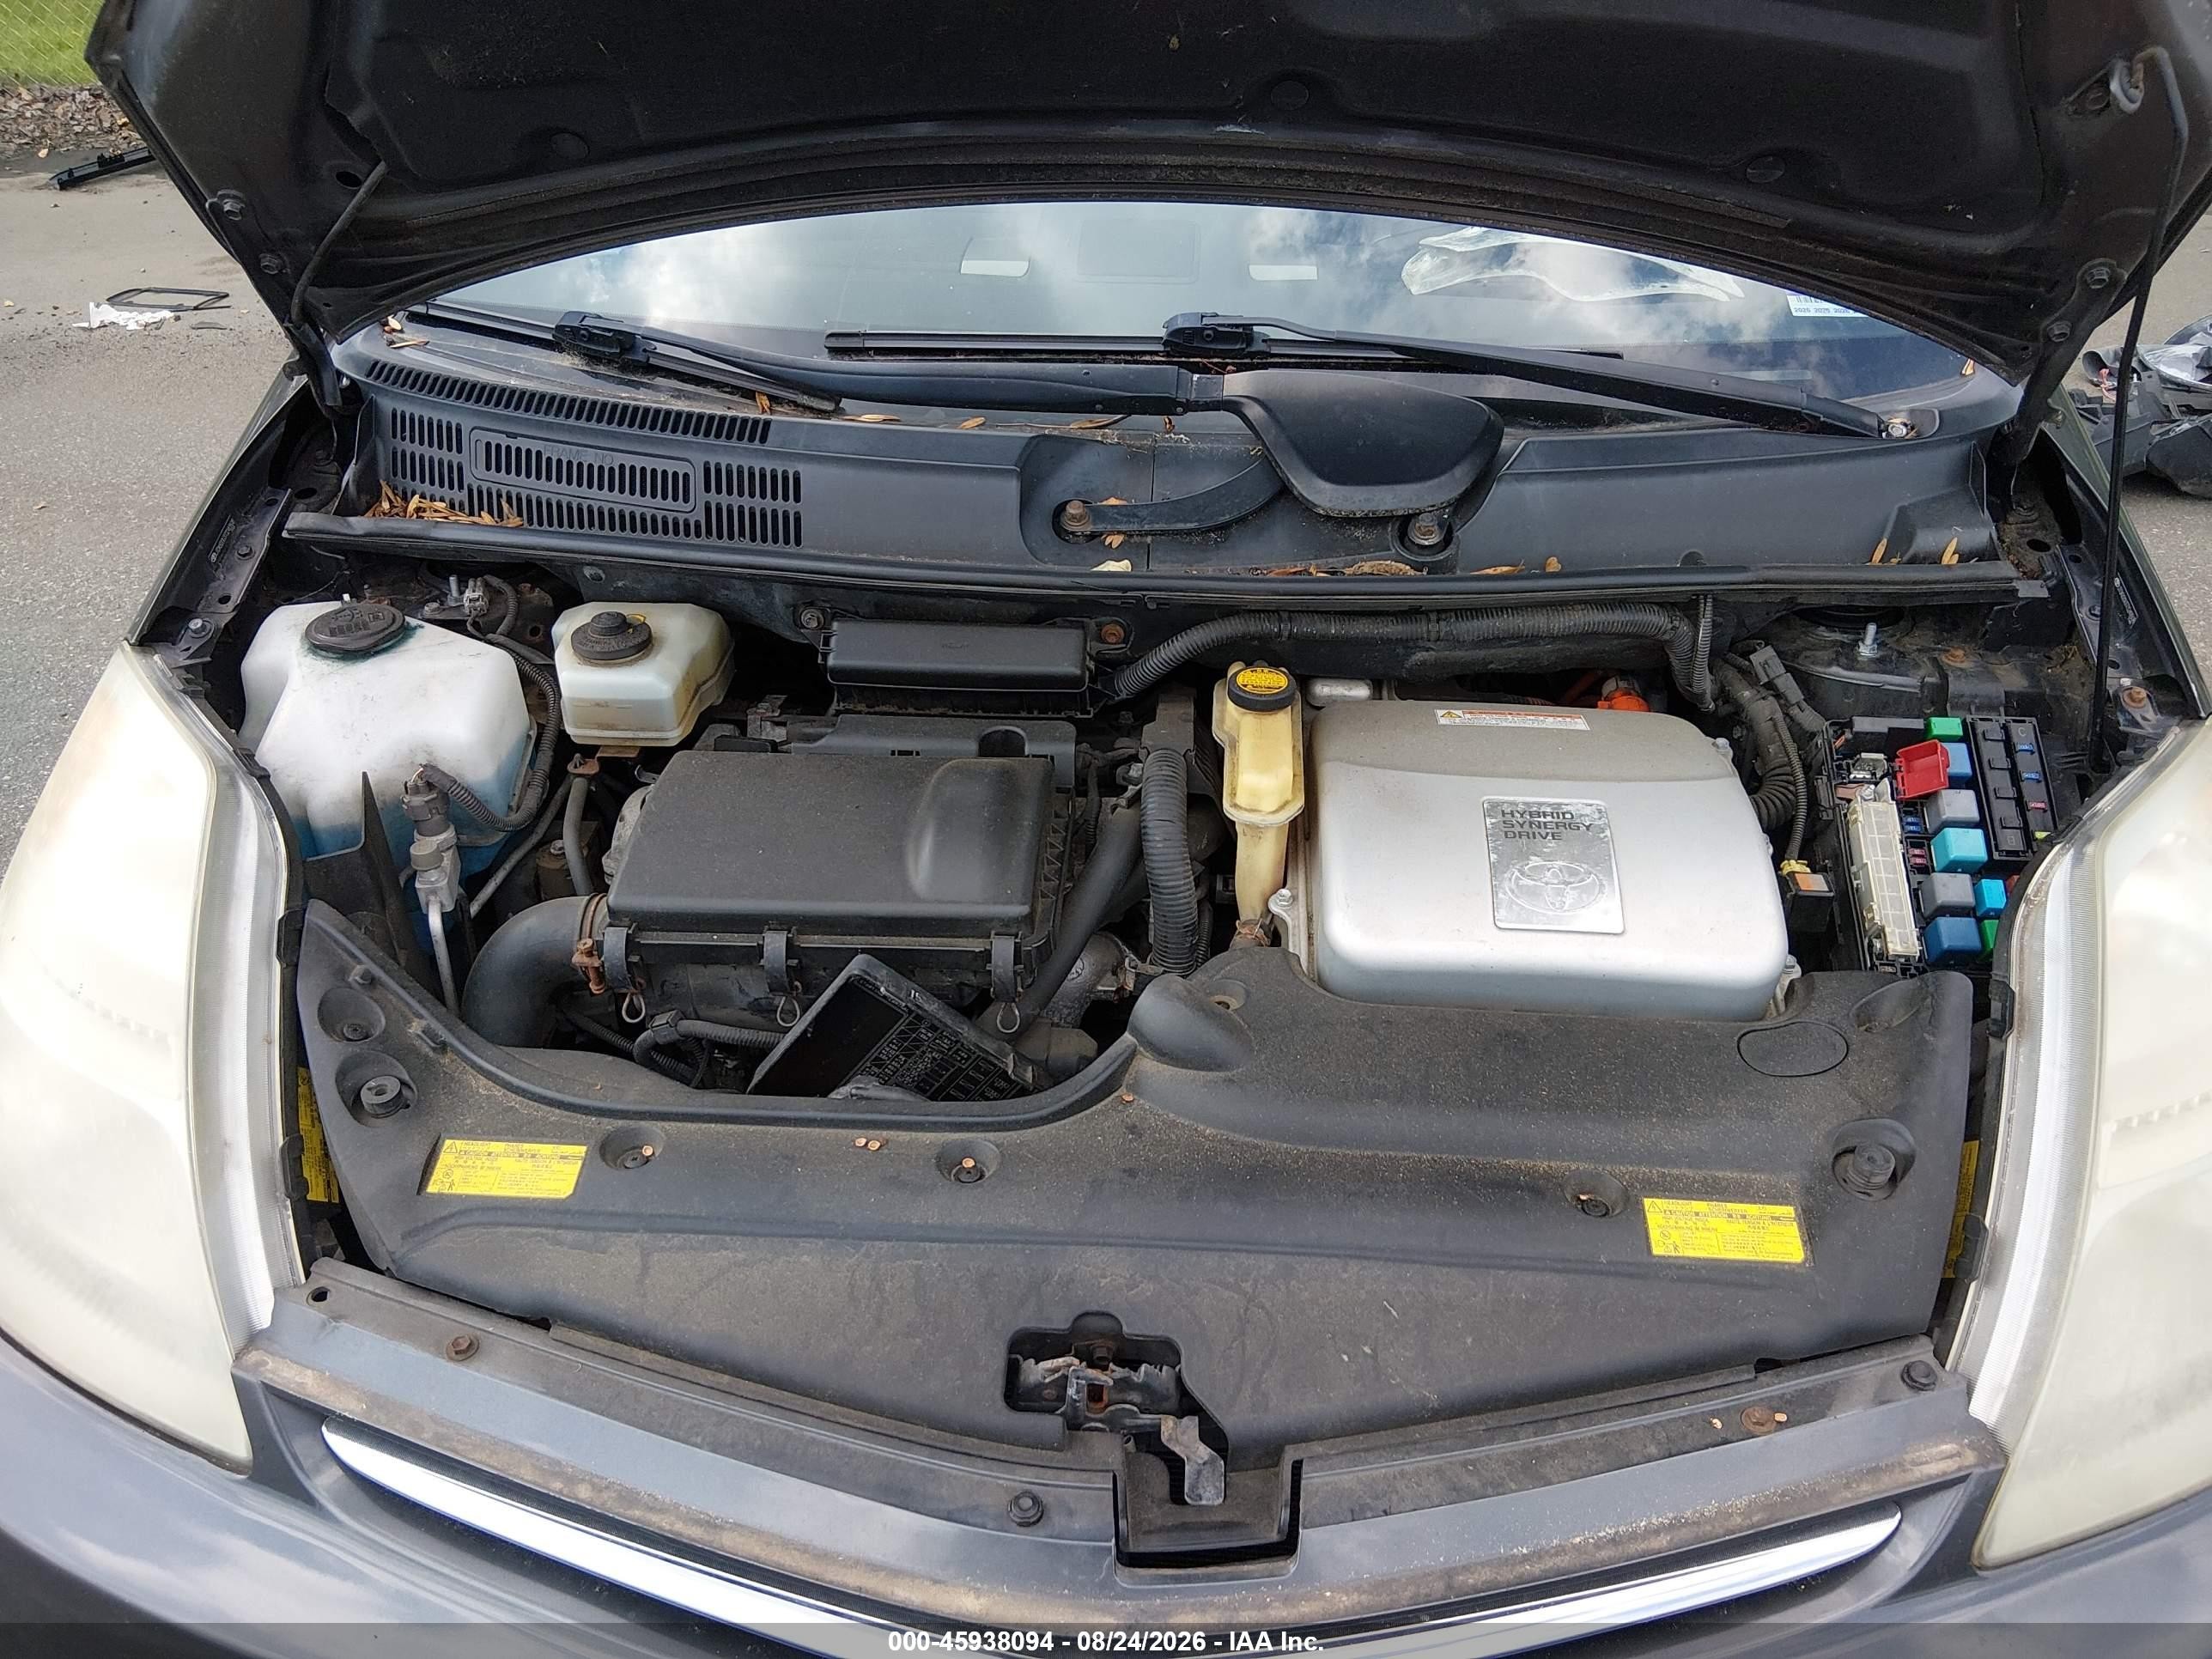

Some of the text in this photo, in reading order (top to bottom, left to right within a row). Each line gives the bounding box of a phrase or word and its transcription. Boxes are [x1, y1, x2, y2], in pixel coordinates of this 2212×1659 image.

[544, 446, 592, 462] FRAME
[1501, 810, 1575, 820] HYBRID
[1502, 819, 1594, 831] SYNERGY
[1504, 830, 1563, 841] DRIVE
